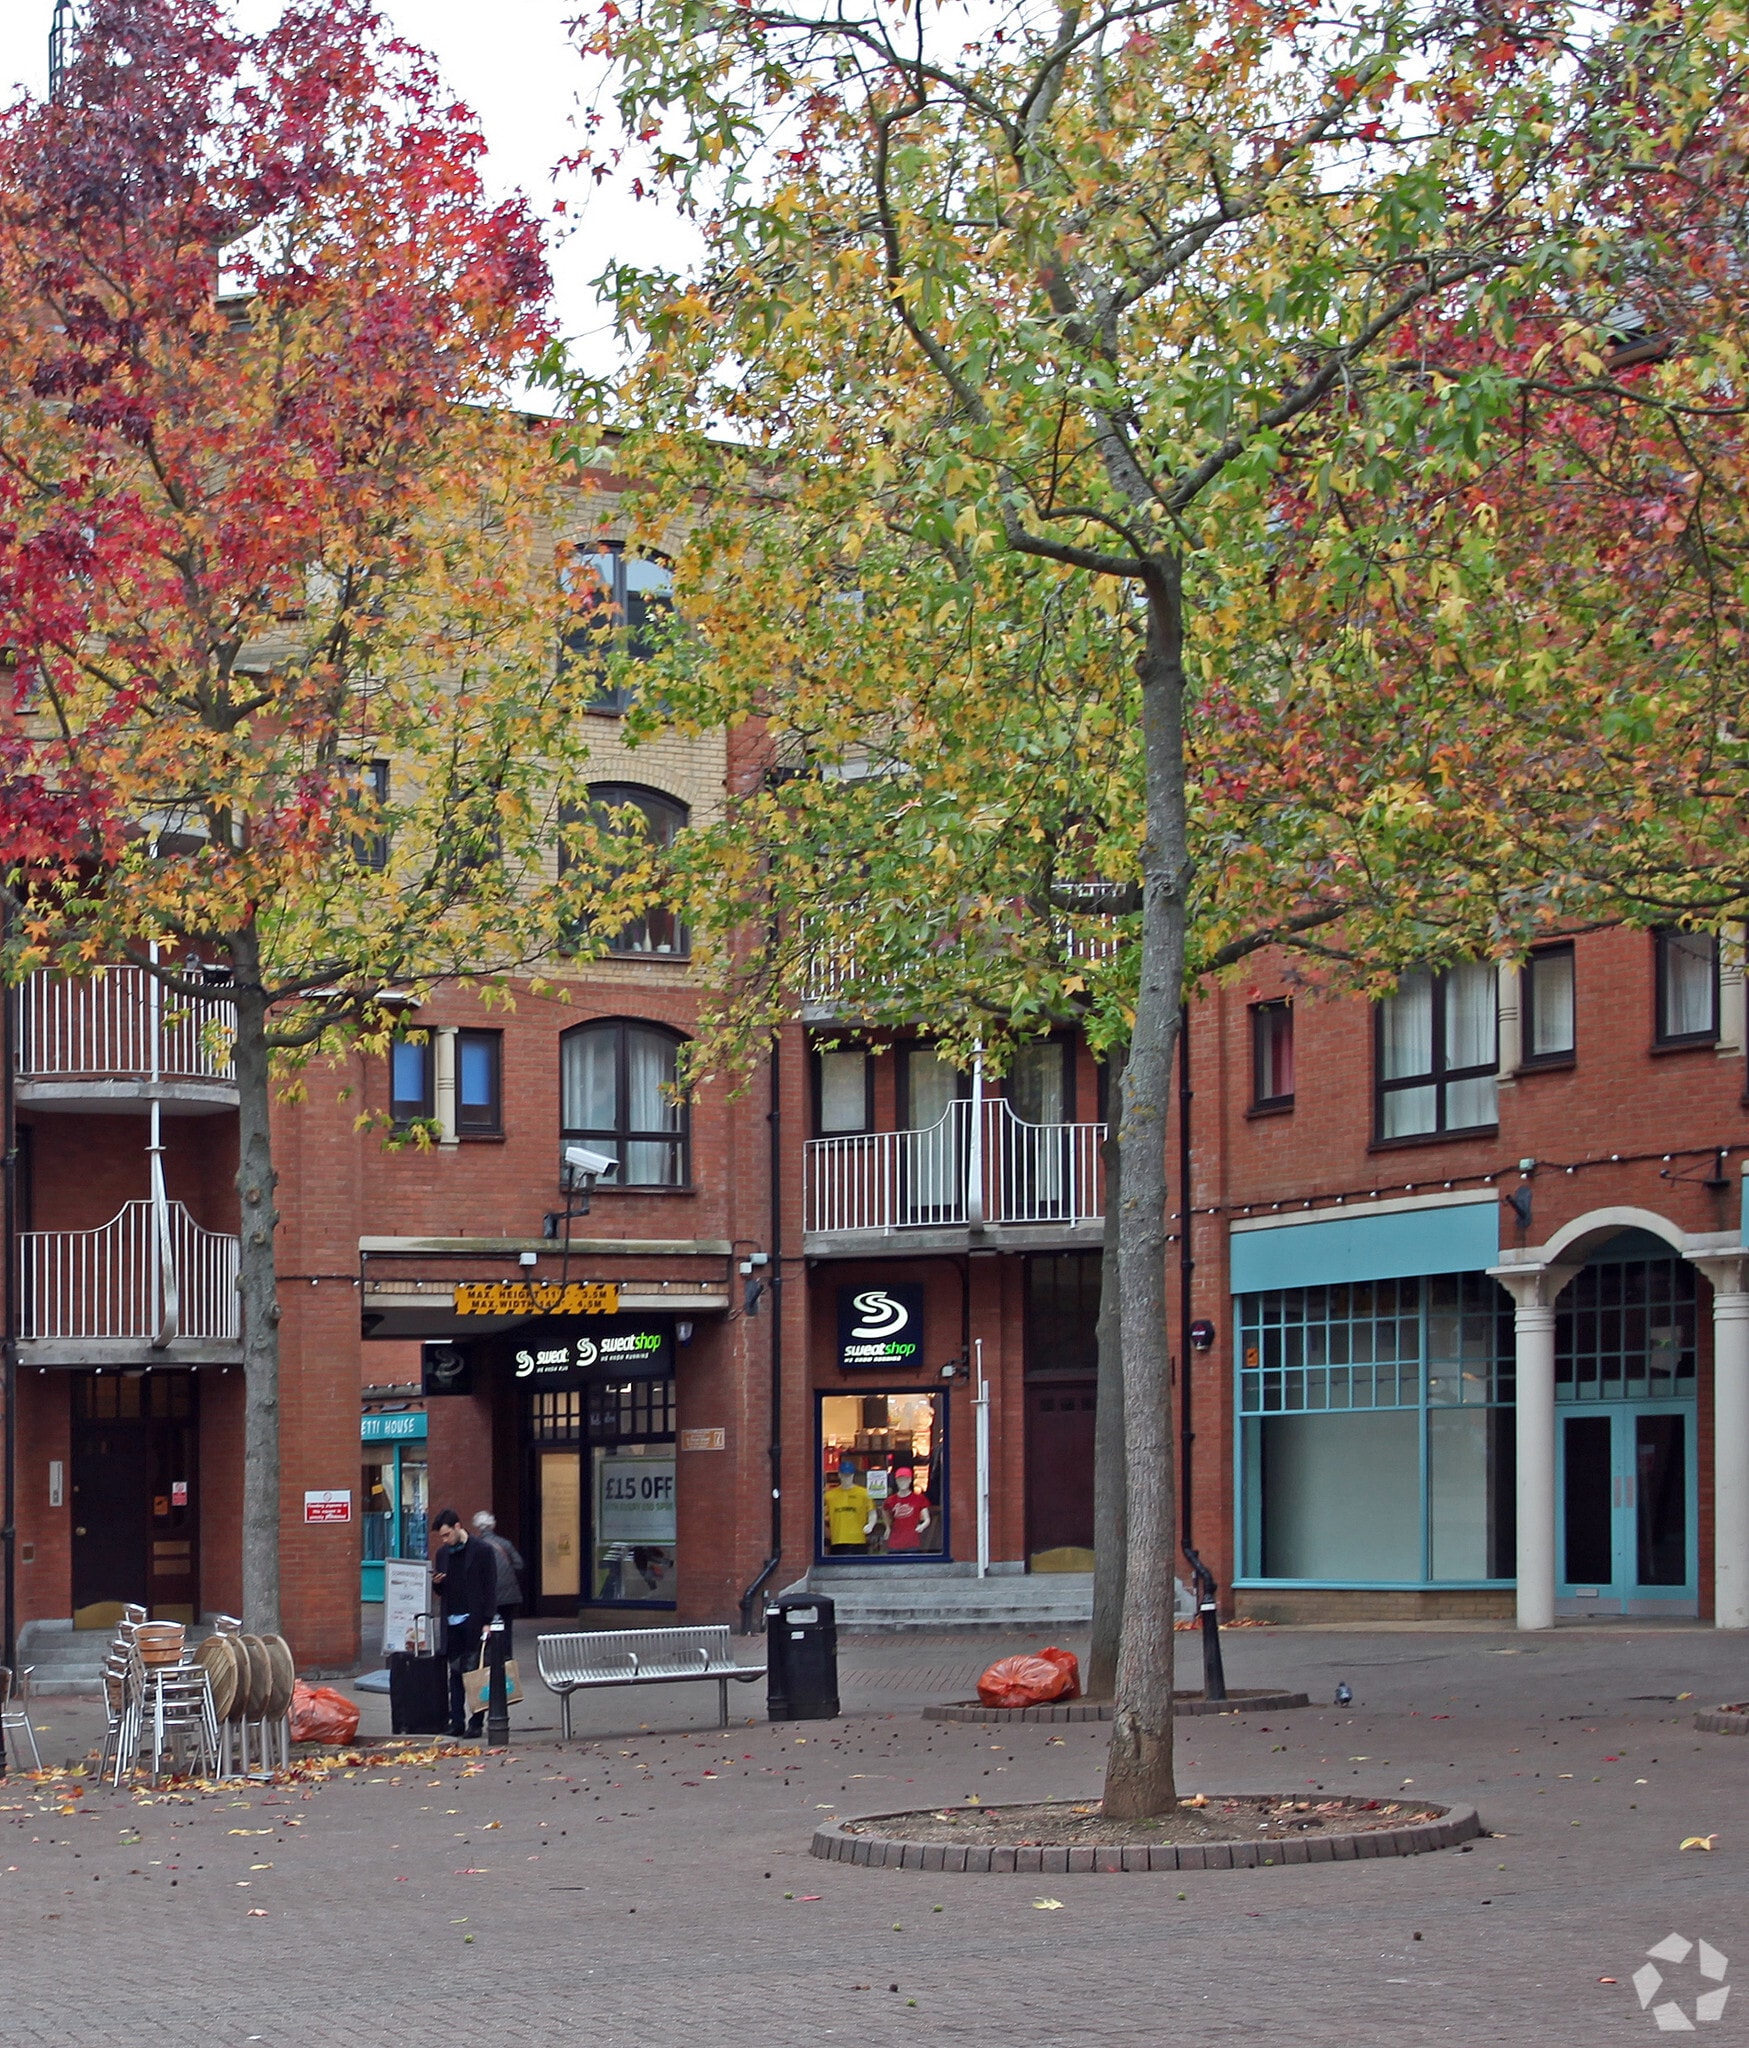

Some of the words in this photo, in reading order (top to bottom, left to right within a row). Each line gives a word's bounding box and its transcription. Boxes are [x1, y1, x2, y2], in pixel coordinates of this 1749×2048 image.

[467, 1291, 495, 1299] MAX.
[499, 1291, 539, 1299] HEIGHT
[582, 1291, 607, 1299] 3.5M
[499, 1300, 534, 1308] WIDTH
[600, 1332, 662, 1352] sweatshop
[844, 1341, 916, 1357] sweatshop
[384, 1417, 415, 1435] HOUSE
[605, 1477, 636, 1499] £15
[641, 1476, 673, 1499] OFF
